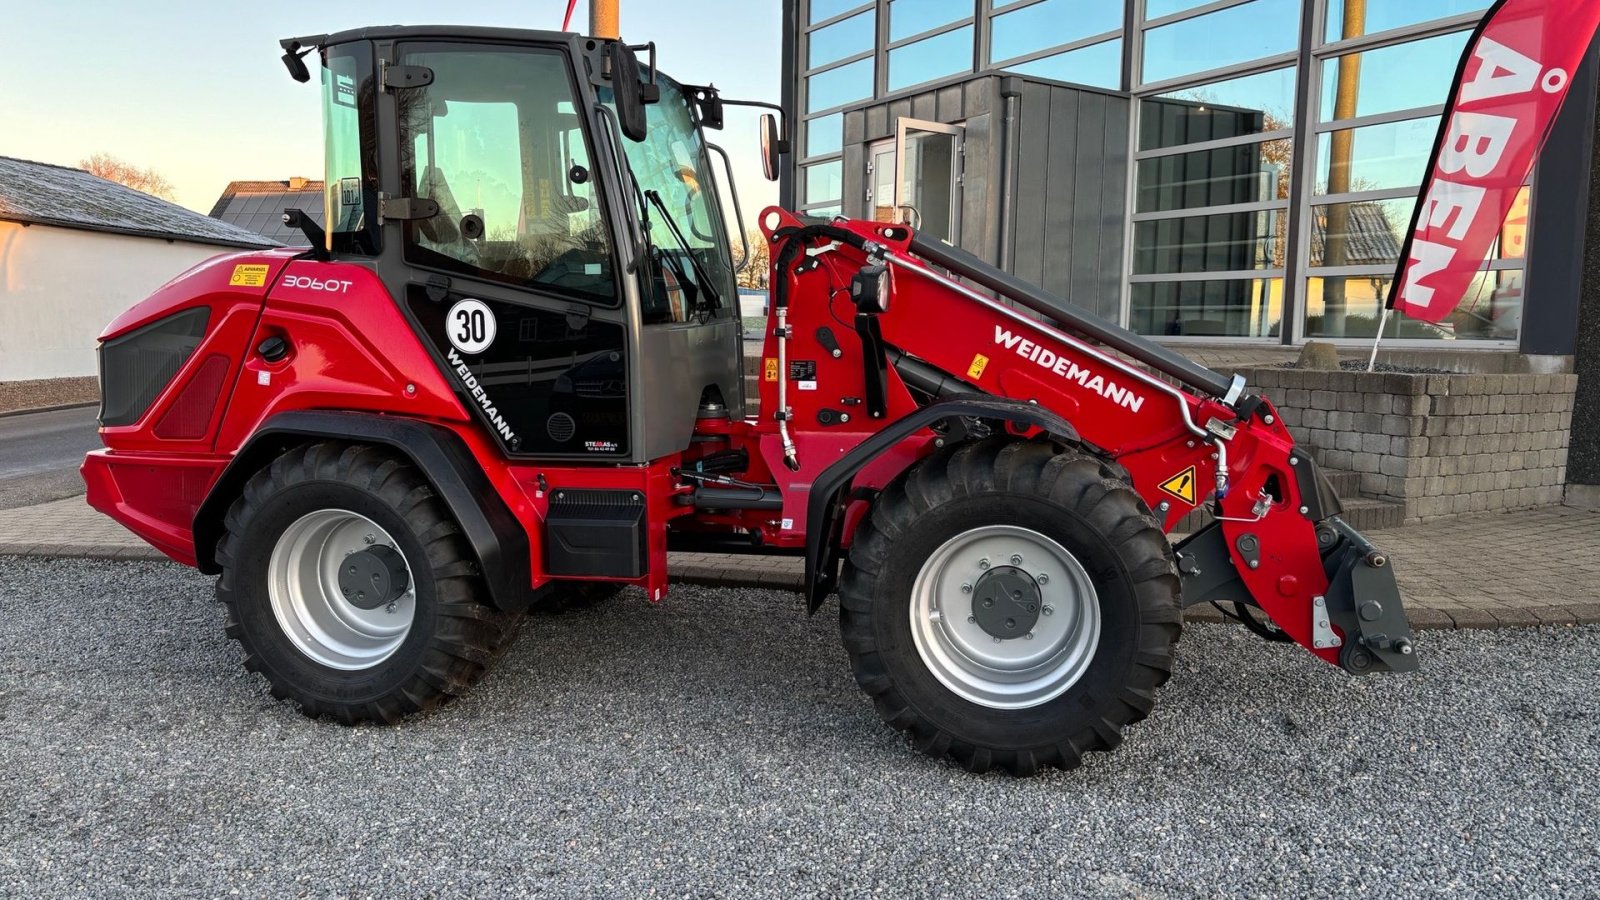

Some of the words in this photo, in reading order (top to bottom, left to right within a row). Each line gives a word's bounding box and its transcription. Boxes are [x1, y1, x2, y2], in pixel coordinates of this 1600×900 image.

[1401, 36, 1568, 308] ÅBEN
[282, 274, 353, 293] 3060T
[456, 309, 486, 343] 30
[447, 347, 514, 441] WEIDEMANN
[994, 325, 1145, 413] WEIDEMANN
